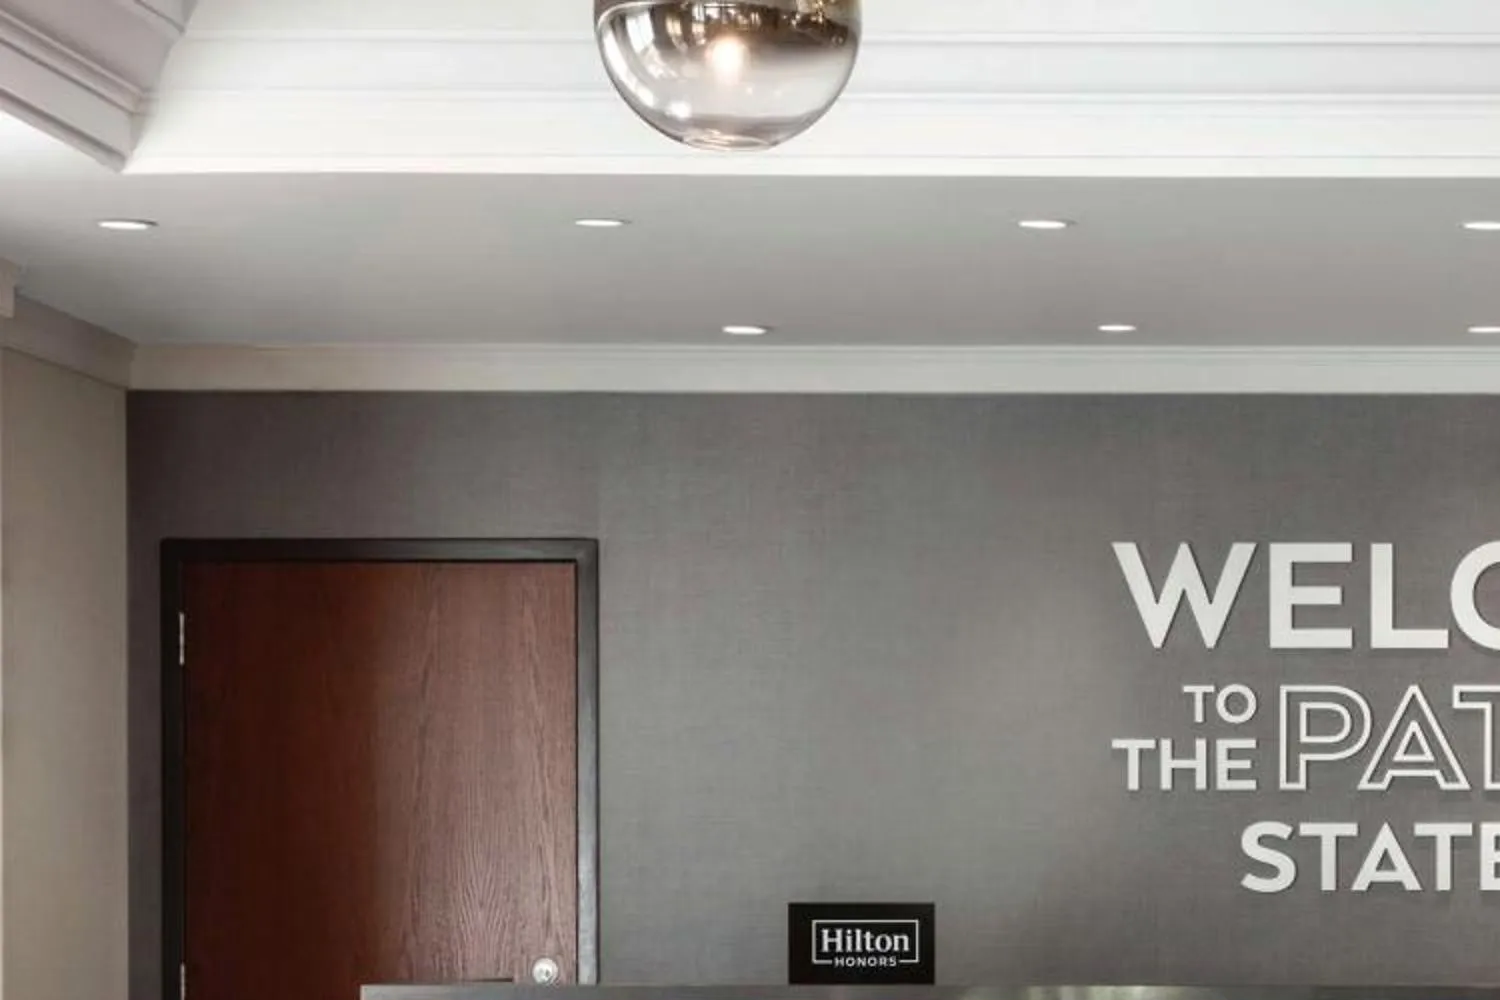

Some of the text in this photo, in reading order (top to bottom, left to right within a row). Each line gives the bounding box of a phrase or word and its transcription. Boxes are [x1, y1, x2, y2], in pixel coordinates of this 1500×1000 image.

[1183, 684, 1258, 725] TO
[1112, 737, 1258, 791] THE
[821, 928, 910, 953] Hilton
[834, 956, 897, 967] HONORS
